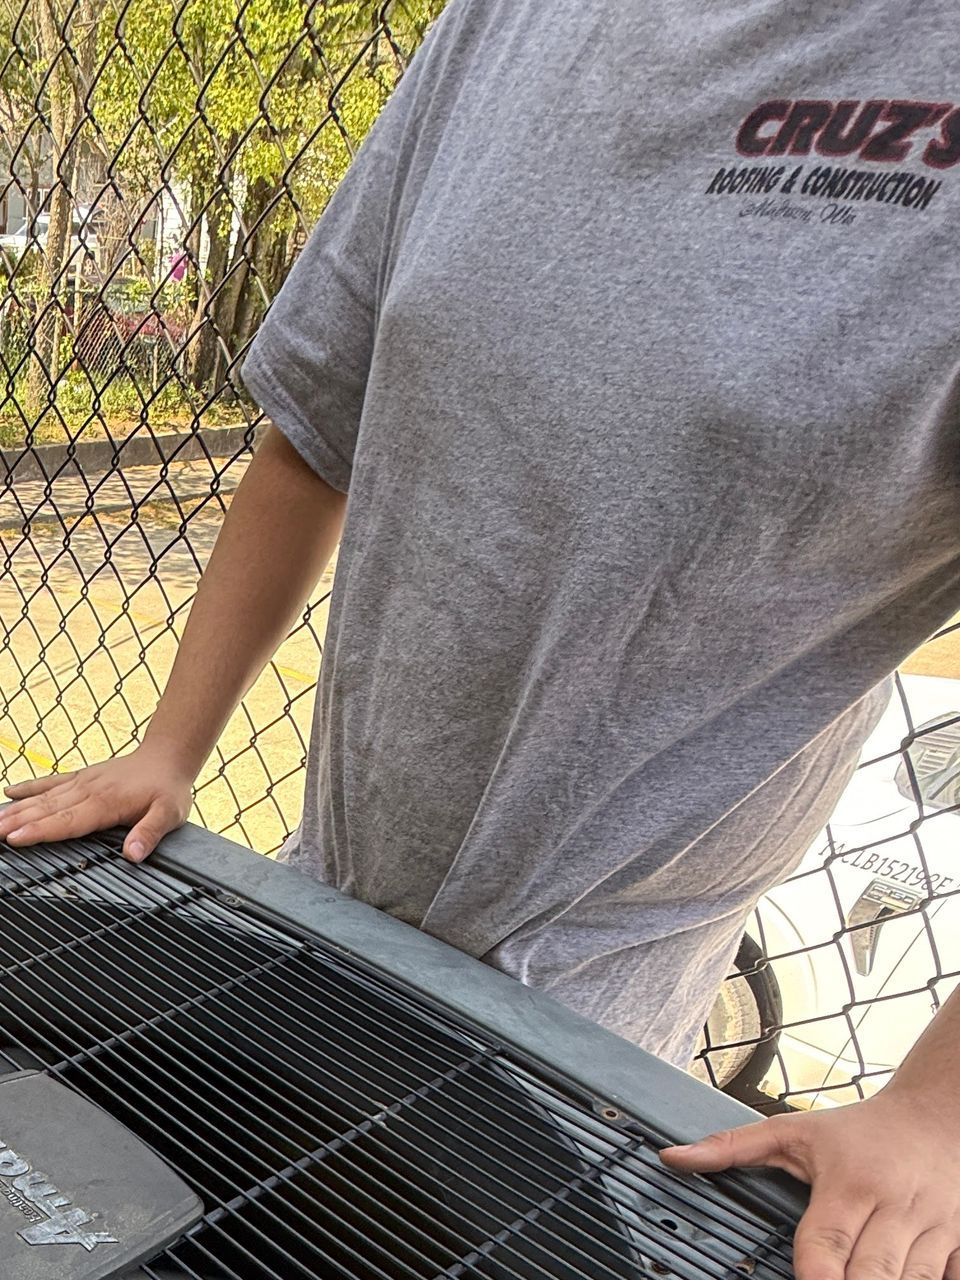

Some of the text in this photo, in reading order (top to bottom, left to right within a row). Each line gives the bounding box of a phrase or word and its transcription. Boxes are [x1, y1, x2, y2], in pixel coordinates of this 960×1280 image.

[705, 165, 943, 211] ROOFING & CONSTRUCTION
